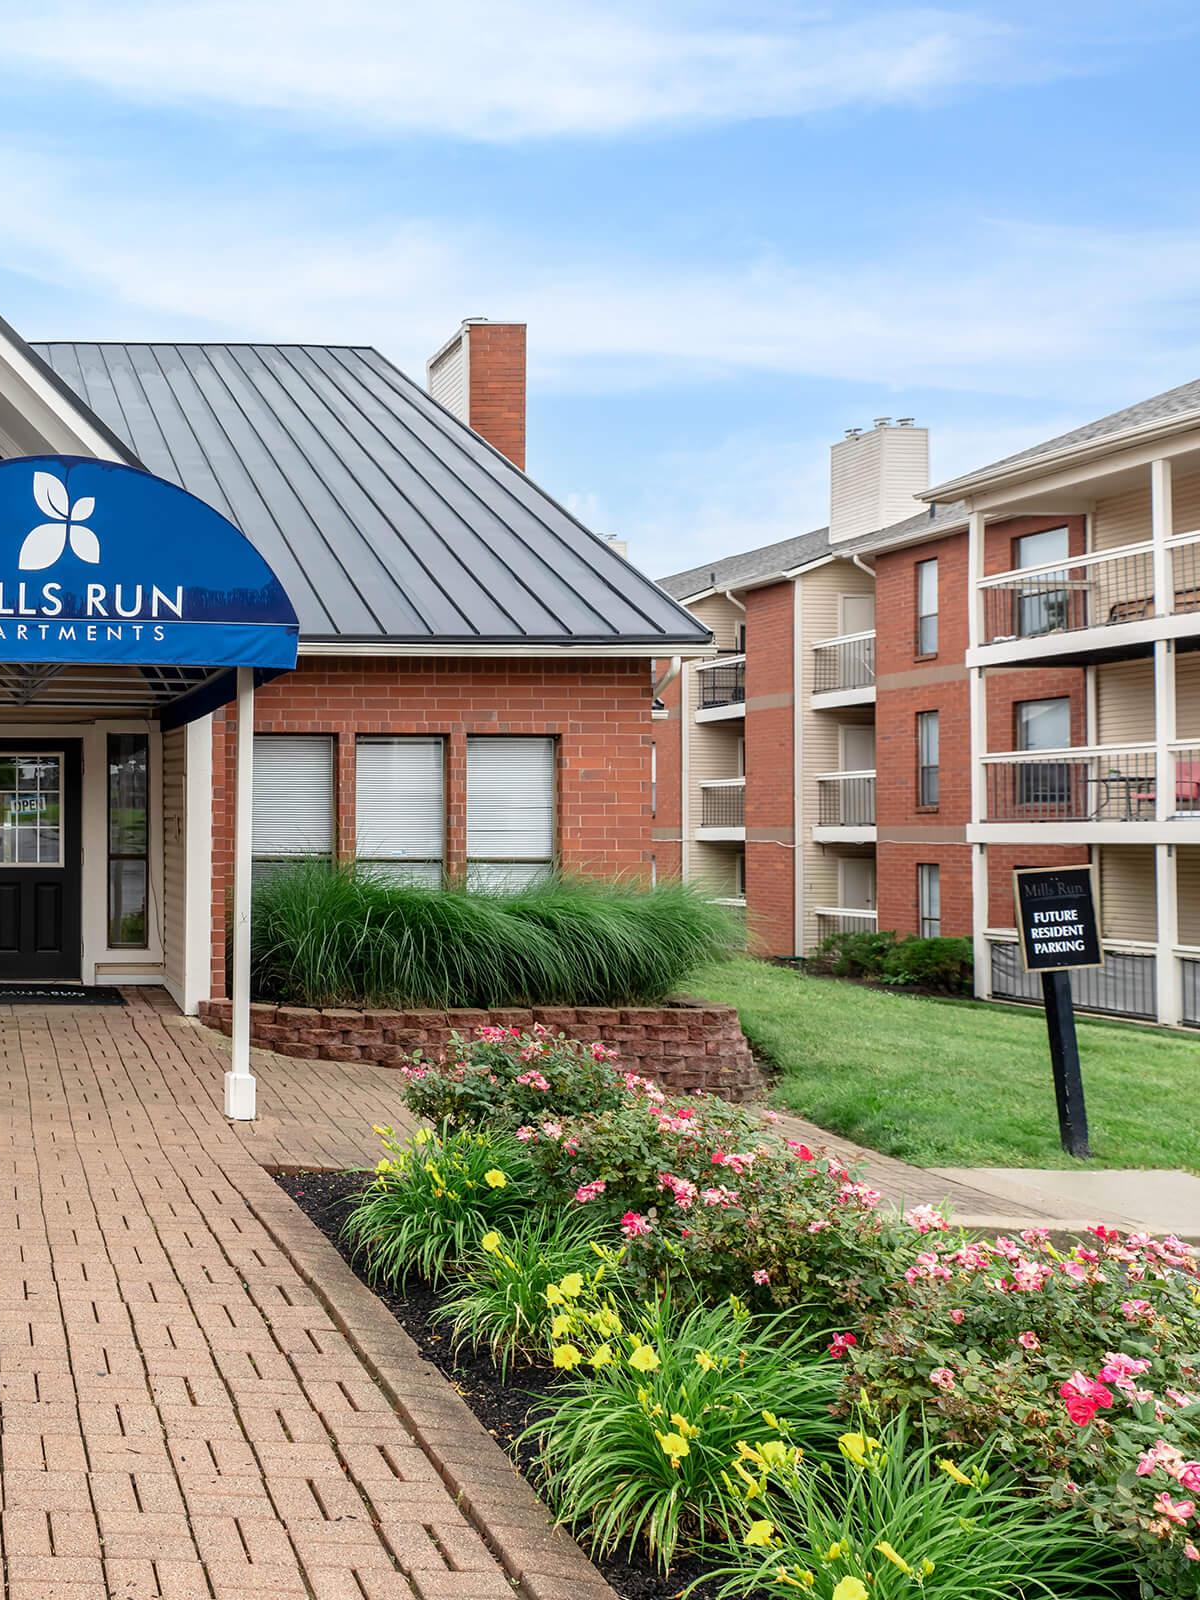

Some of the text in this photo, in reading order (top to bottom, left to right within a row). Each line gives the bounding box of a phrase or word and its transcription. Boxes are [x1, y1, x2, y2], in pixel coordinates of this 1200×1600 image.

[86, 582, 184, 619] RUN
[14, 799, 44, 812] OPEN
[1057, 881, 1084, 896] Run
[1033, 909, 1078, 923] FUTURE
[1030, 924, 1085, 939] RESIDENT
[1034, 940, 1086, 954] PARKING
